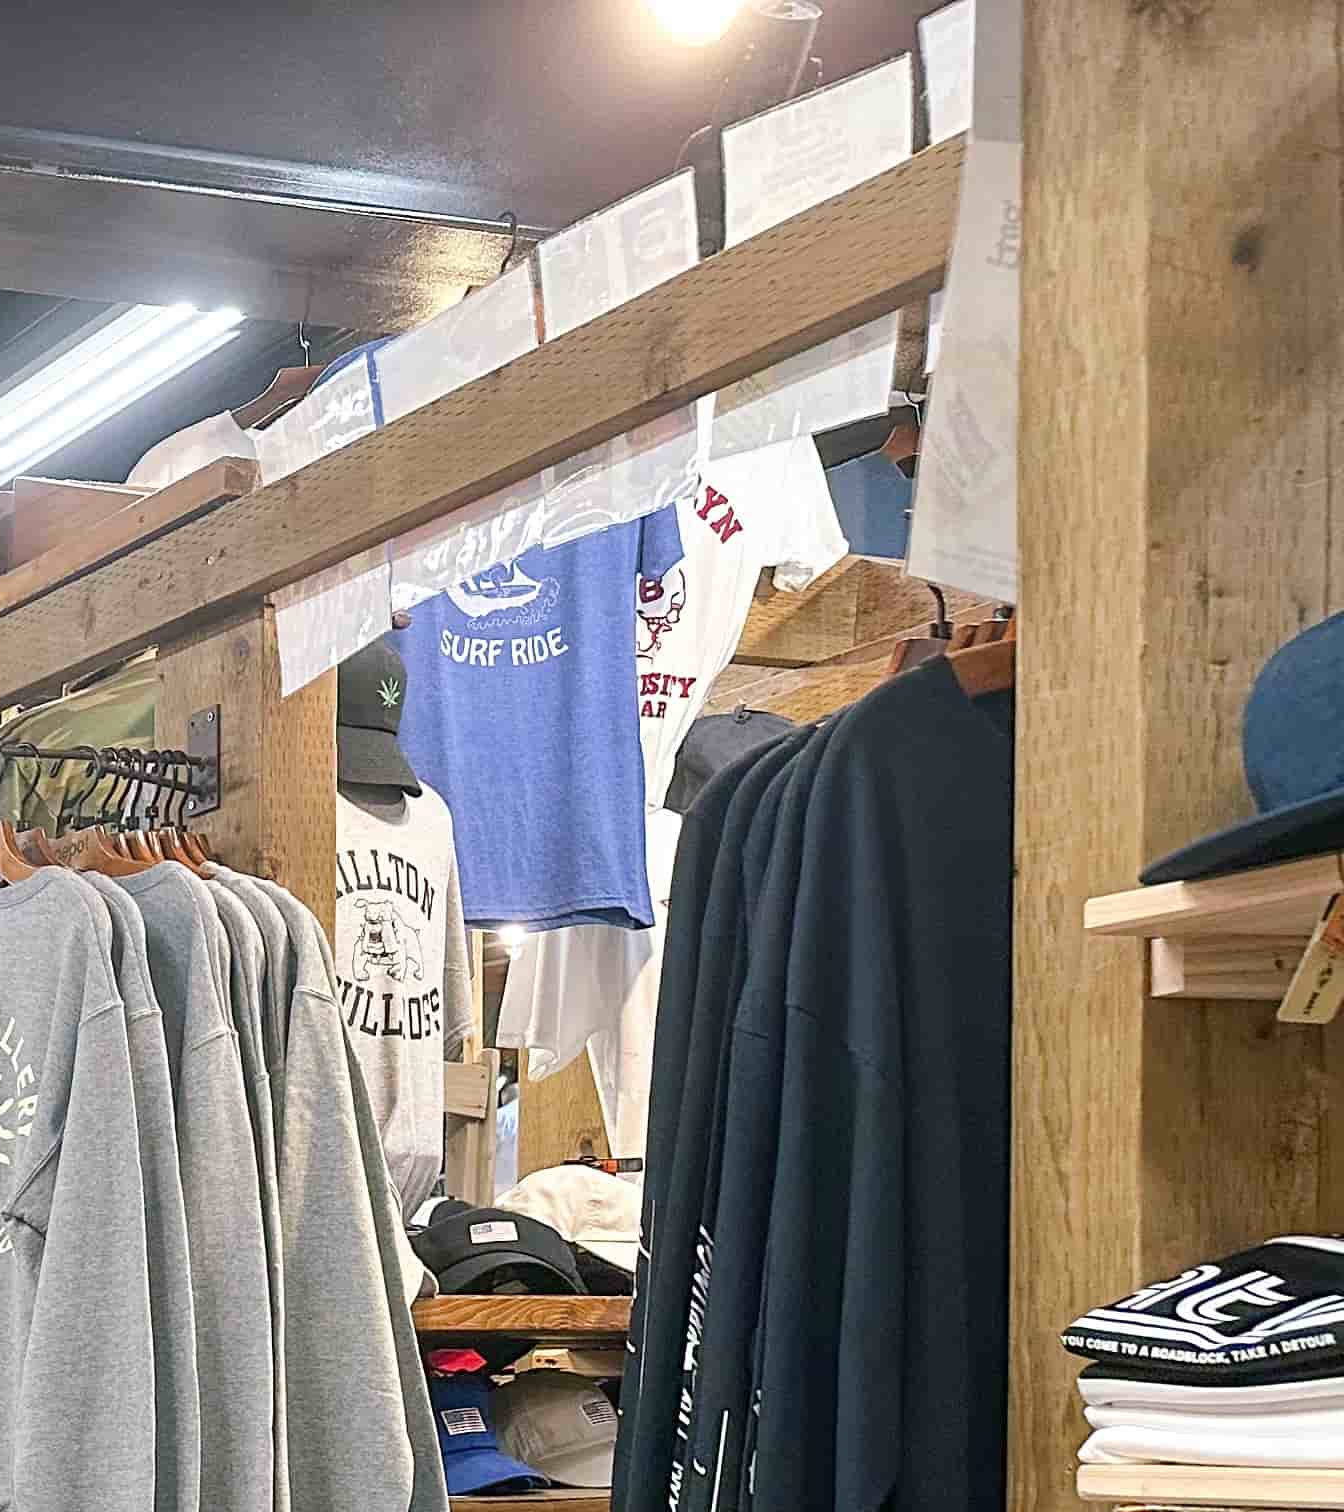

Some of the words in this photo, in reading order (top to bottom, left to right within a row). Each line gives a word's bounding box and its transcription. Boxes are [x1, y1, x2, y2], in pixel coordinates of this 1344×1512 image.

[439, 627, 503, 668] SURF
[511, 625, 569, 667] RIDE
[1060, 1334, 1084, 1349] YOU
[1086, 1338, 1119, 1353] COME
[1120, 1341, 1137, 1356] TO
[1138, 1344, 1149, 1358] A
[1232, 1347, 1267, 1363] TAKE
[1269, 1342, 1280, 1356] A
[1281, 1333, 1337, 1353] DETOUR
